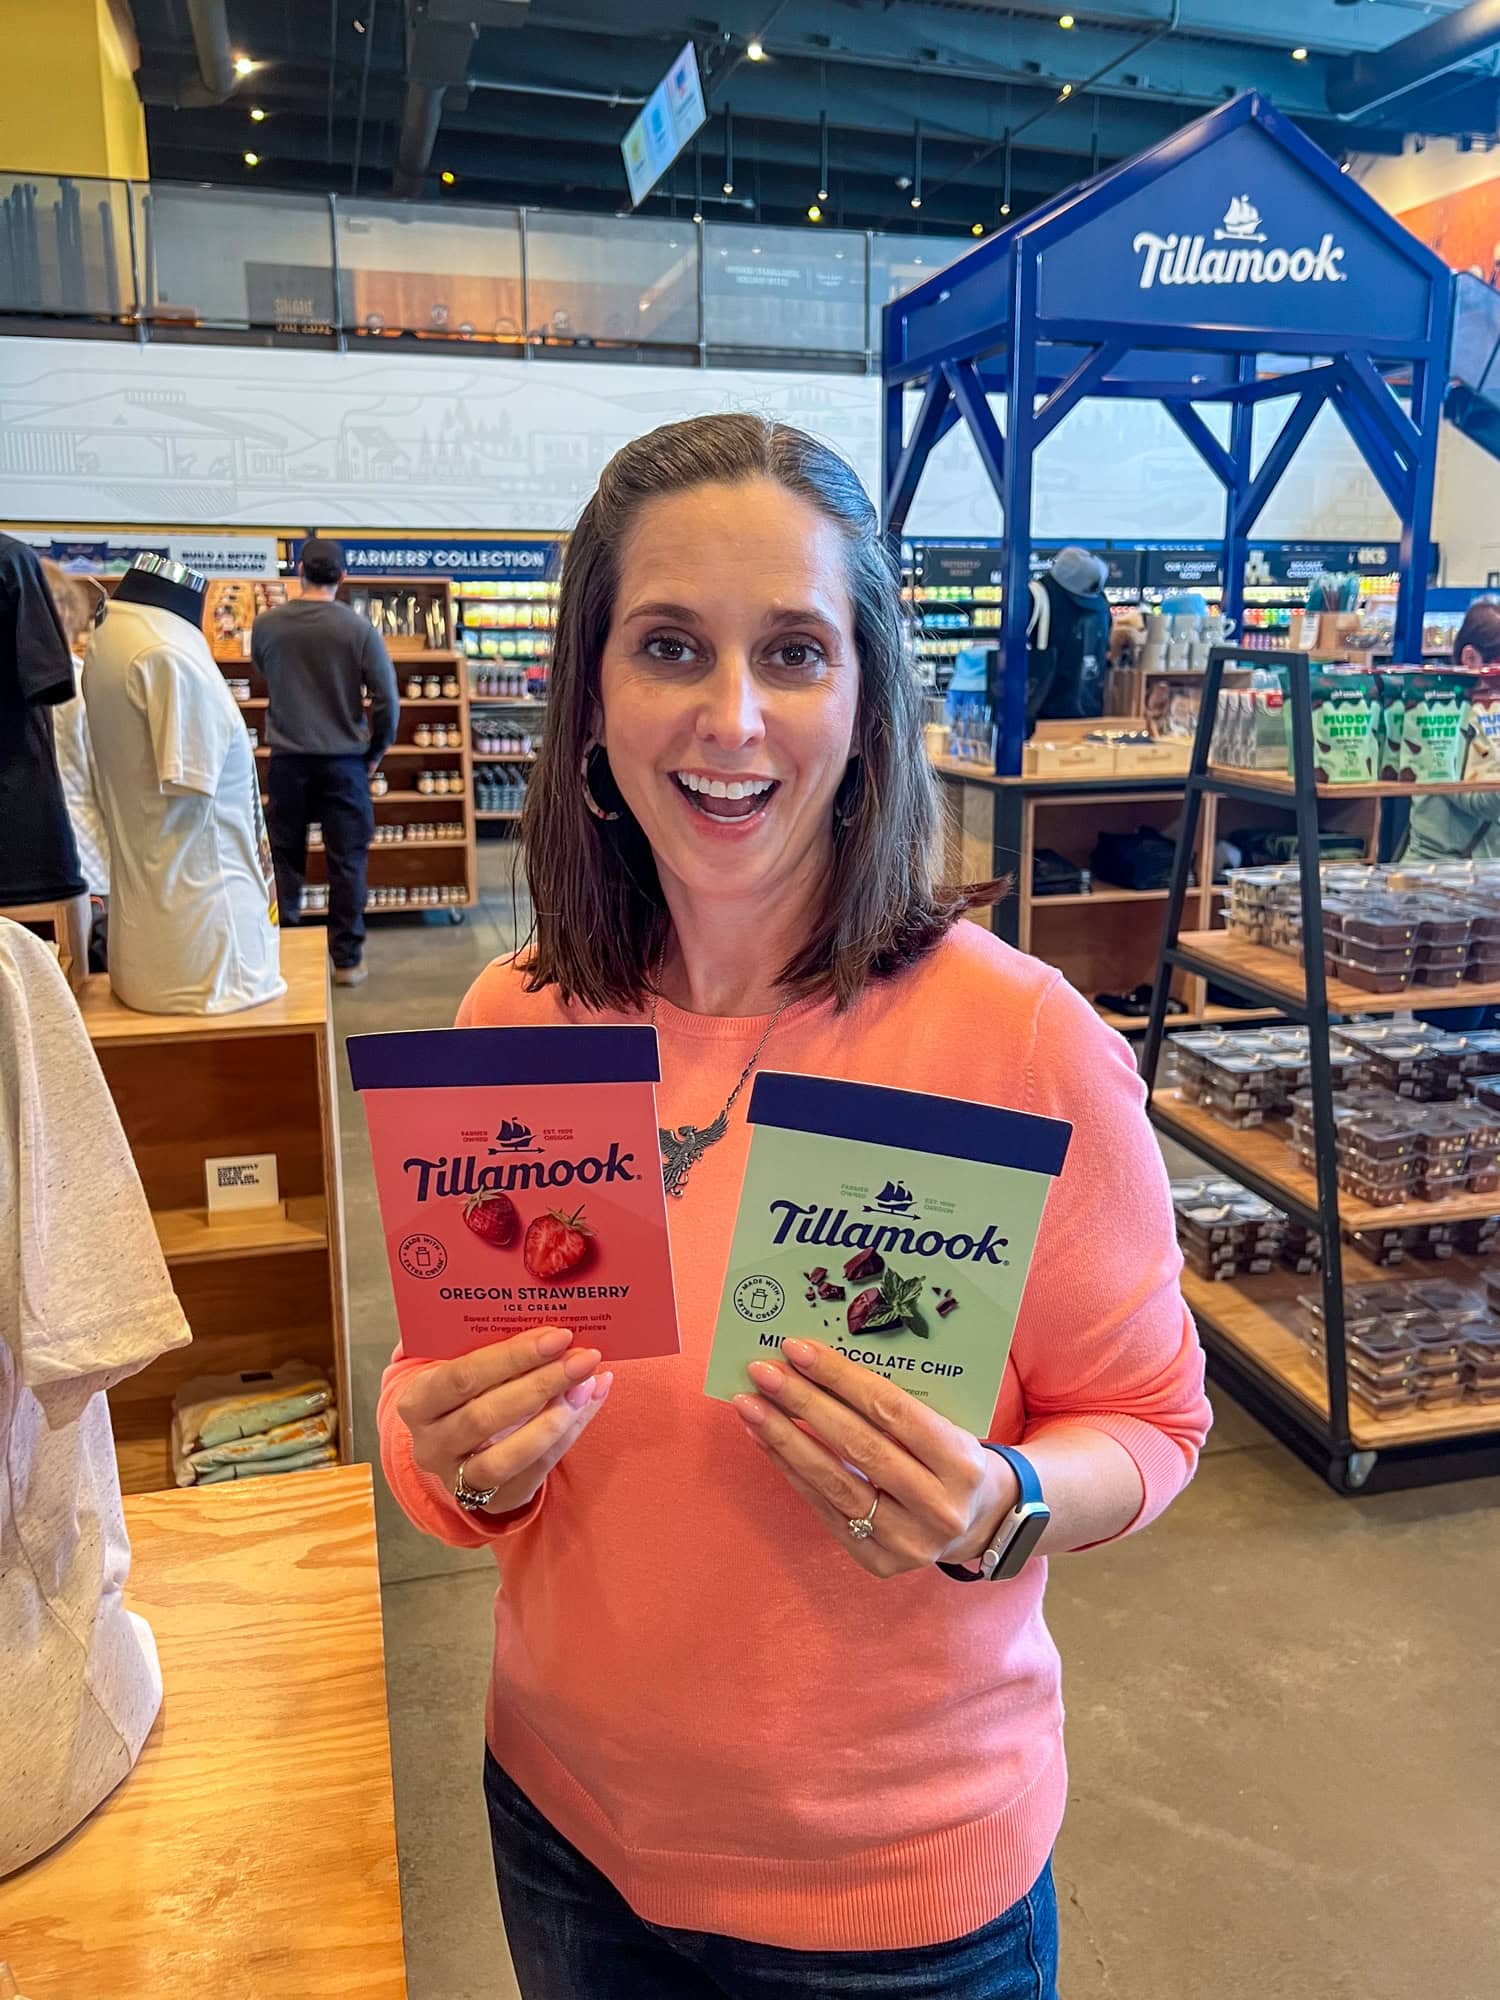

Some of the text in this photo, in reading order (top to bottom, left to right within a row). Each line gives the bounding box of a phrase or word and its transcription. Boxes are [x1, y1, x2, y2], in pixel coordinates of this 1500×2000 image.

[1133, 231, 1346, 289] Tillamook
[346, 550, 545, 567] FARMERS' COLLECTION
[1323, 715, 1371, 726] MUDDY
[1416, 714, 1460, 726] MUDDY
[403, 1142, 634, 1202] Tillamook
[769, 1199, 1009, 1265] Tillamook
[403, 1237, 440, 1250] MADE WITH
[404, 1259, 423, 1275] EXTRA
[439, 1286, 630, 1300] OREGON STRAWBERRY
[741, 1278, 780, 1296] MADE WITH
[503, 1303, 567, 1312] ICE CREAM
[737, 1299, 779, 1320] EXTRA CREAM
[492, 1315, 544, 1324] strawberry
[590, 1313, 612, 1321] with
[490, 1325, 524, 1333] Oregon
[921, 1360, 964, 1378] CHIP
